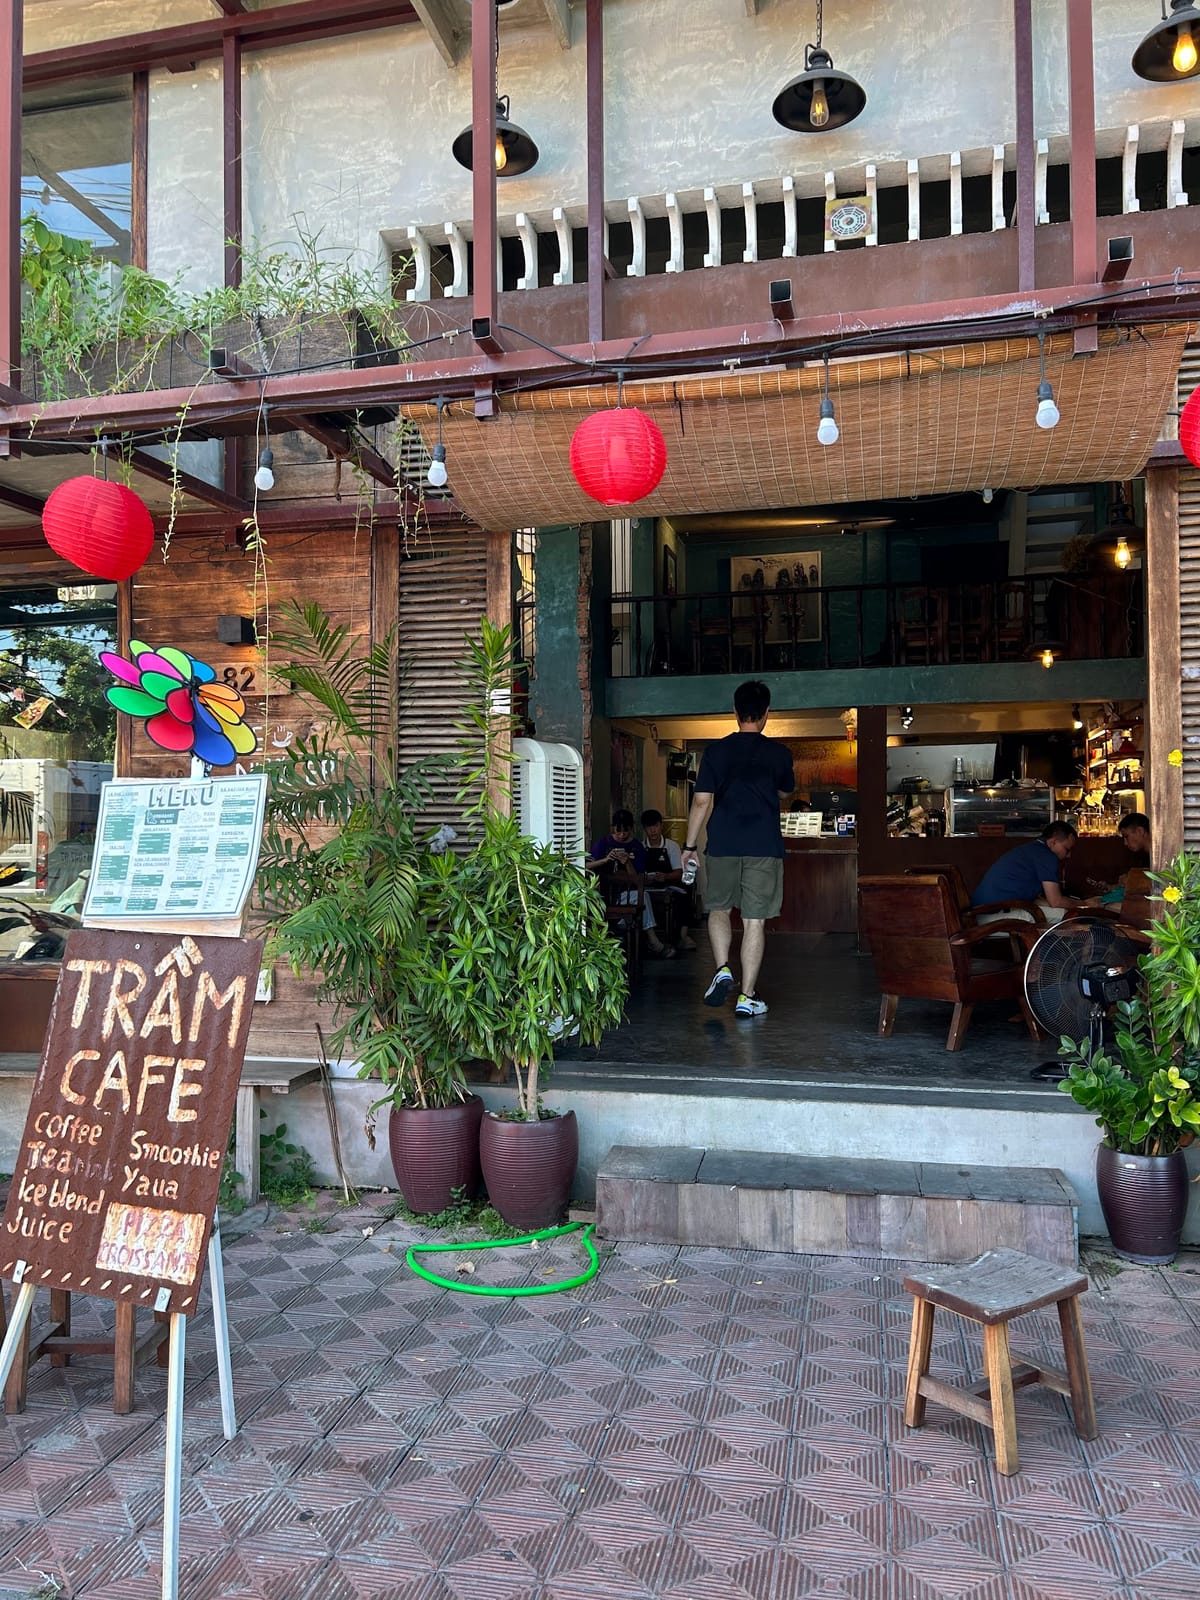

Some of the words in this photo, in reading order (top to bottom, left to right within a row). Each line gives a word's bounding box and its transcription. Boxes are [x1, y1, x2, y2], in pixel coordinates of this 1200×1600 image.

[149, 783, 218, 808] MENU
[59, 1049, 207, 1123] CAFE
[27, 1140, 72, 1173] Tea
[129, 1129, 220, 1169] Smoothie
[7, 1206, 73, 1244] Juice
[122, 1208, 186, 1240] PIZZA
[97, 1241, 196, 1274] CROISSANT
